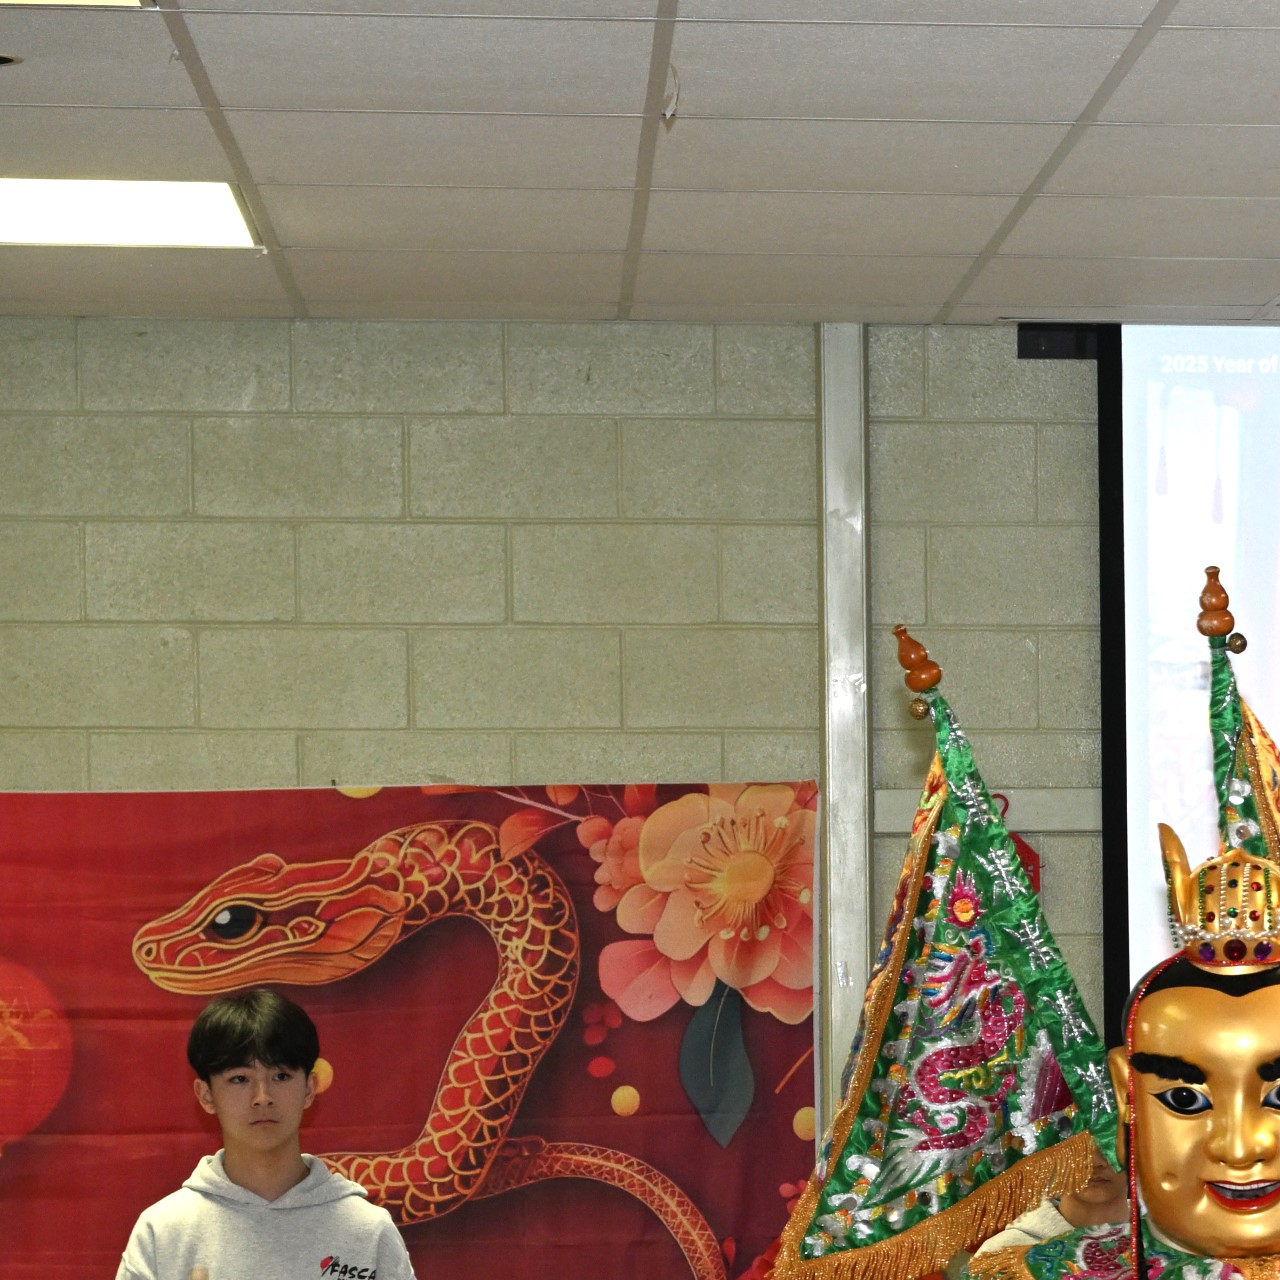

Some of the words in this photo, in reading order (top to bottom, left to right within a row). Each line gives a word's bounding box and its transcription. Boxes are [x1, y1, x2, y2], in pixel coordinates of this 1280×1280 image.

[1161, 355, 1208, 374] 2025
[1212, 355, 1255, 374] Year
[1259, 354, 1278, 374] of
